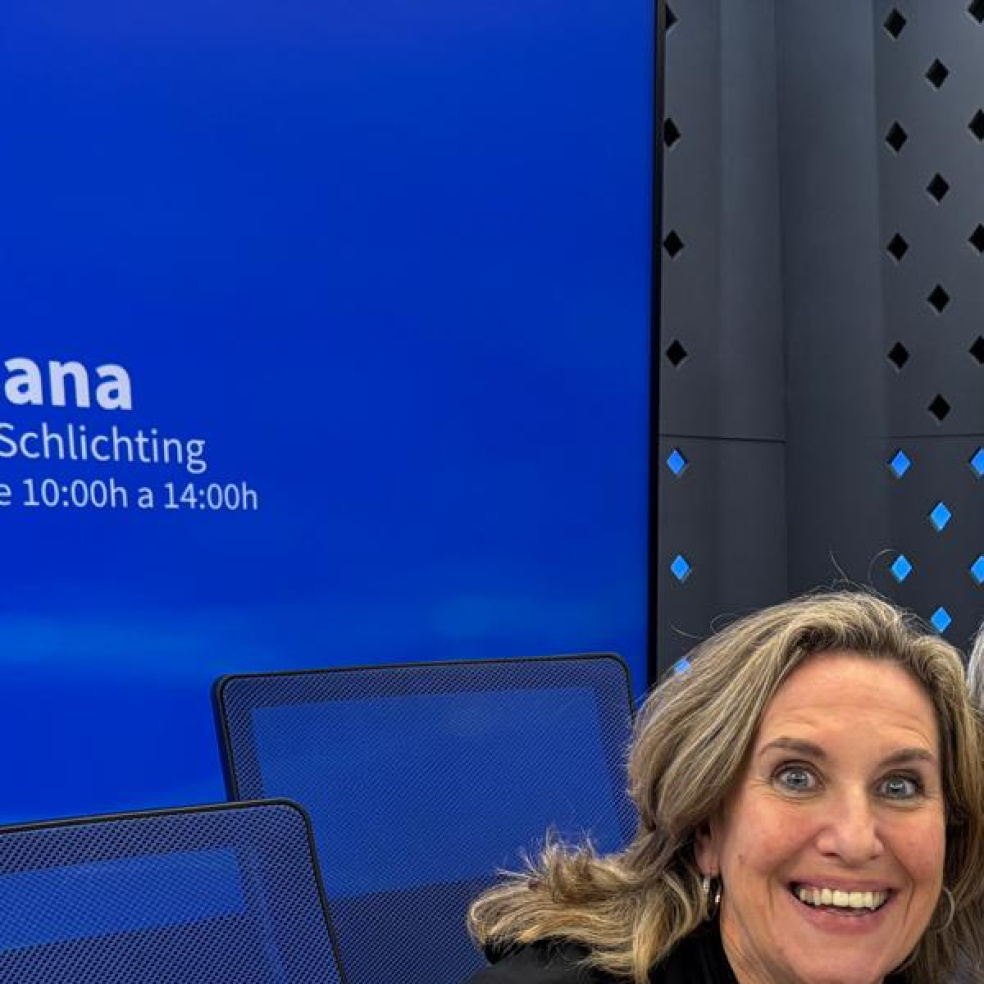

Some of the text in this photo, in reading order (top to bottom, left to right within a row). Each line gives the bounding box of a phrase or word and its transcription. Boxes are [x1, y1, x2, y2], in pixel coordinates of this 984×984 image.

[0, 421, 207, 475] Schlichting
[23, 477, 128, 508] 10:00h
[137, 486, 154, 509] a
[164, 481, 258, 511] 14:00h
